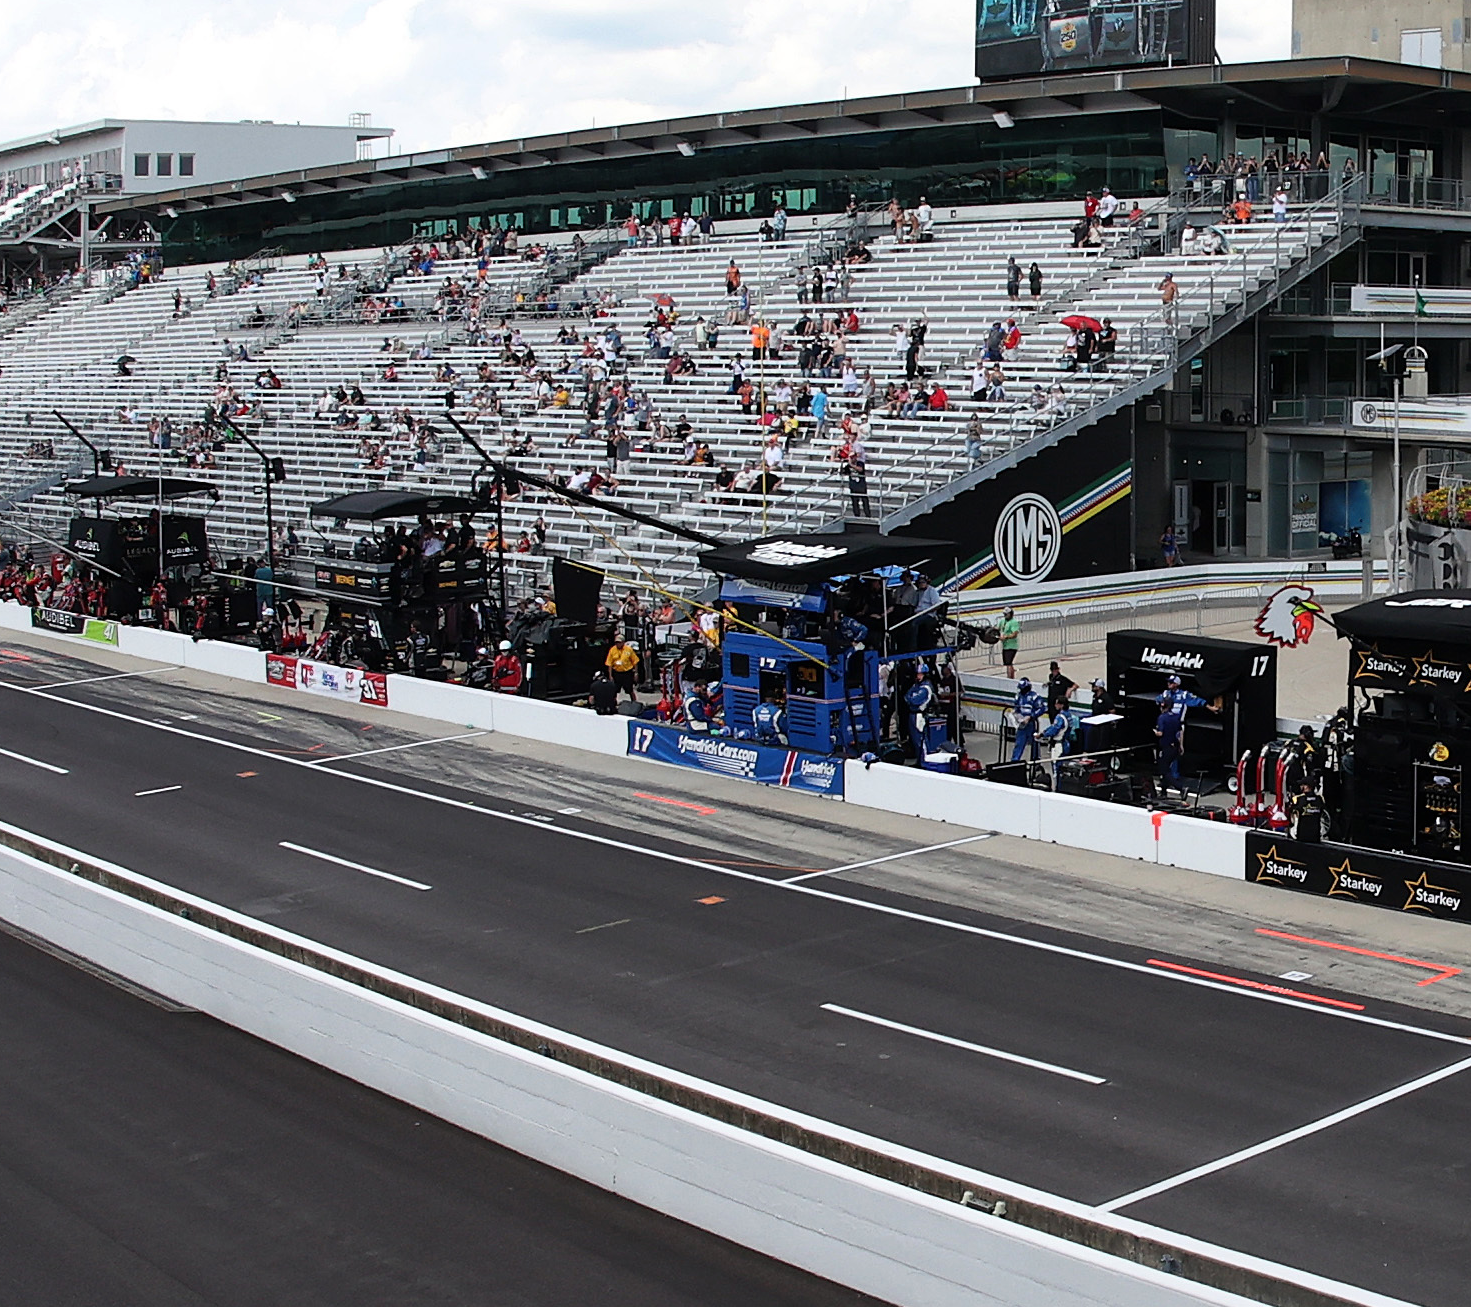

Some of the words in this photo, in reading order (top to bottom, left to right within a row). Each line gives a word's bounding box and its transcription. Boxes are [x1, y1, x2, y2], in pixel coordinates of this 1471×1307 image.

[75, 540, 101, 552] AUDIBEL
[1007, 505, 1052, 568] IMS
[42, 610, 75, 627] AUDIBEL
[368, 619, 382, 638] 31
[104, 624, 114, 639] 41
[759, 657, 776, 668] 17
[1141, 647, 1204, 671] Hendrick
[1251, 655, 1269, 677] 17
[1421, 664, 1462, 683] Starkey
[359, 678, 377, 700] 31
[633, 727, 654, 752] 17
[1266, 861, 1307, 882] Starkey
[1340, 874, 1382, 896] Starkey
[1416, 888, 1460, 910] Starkey
